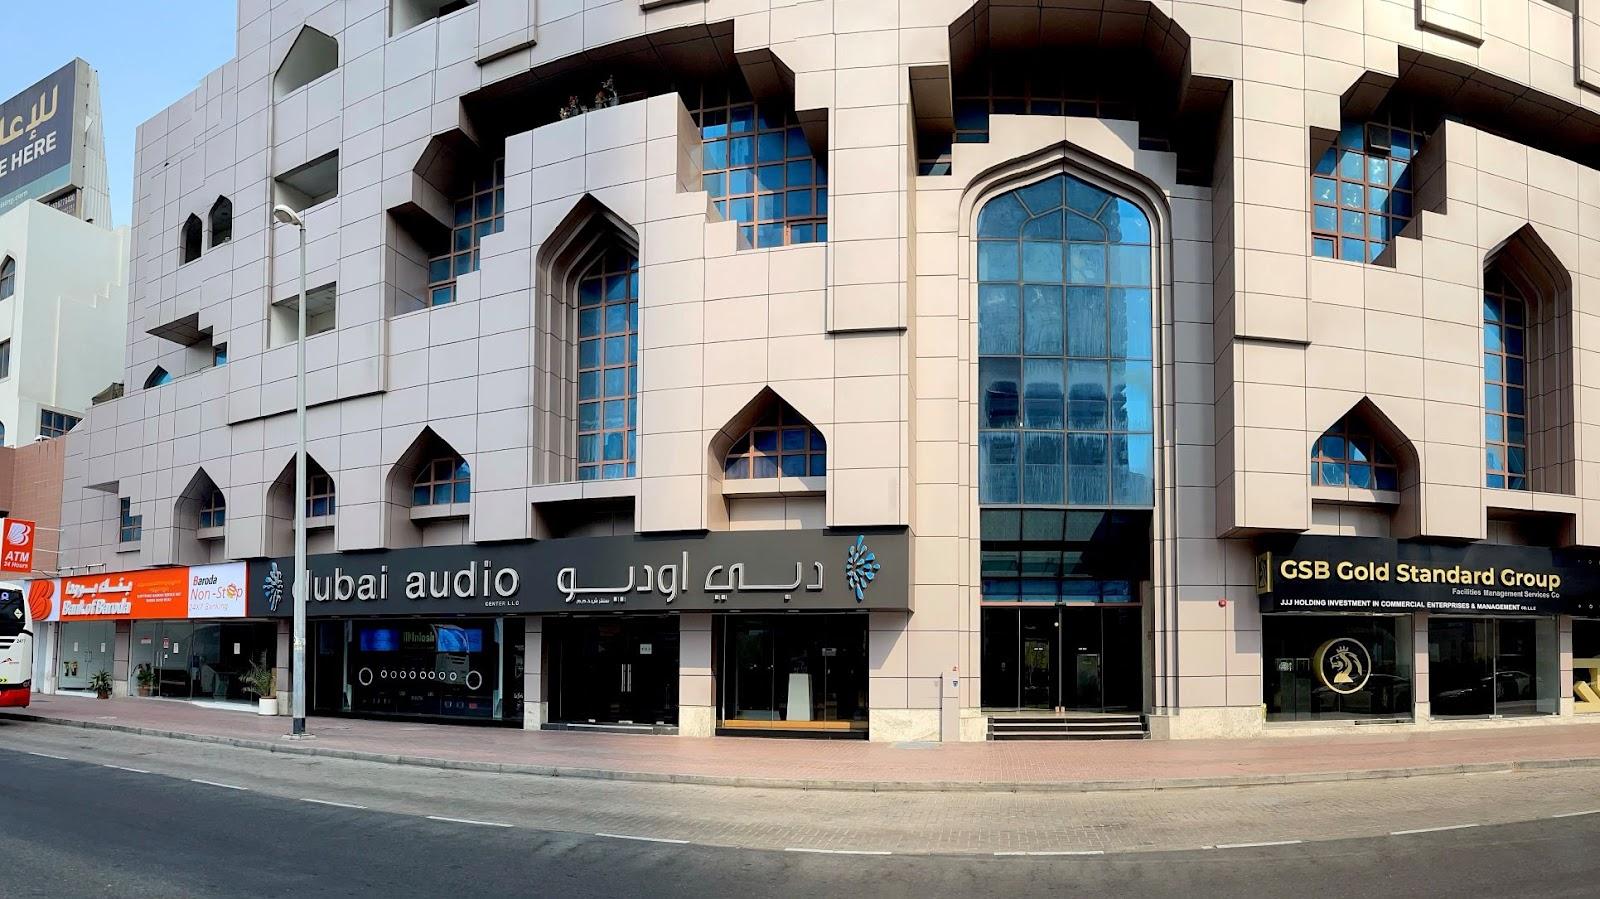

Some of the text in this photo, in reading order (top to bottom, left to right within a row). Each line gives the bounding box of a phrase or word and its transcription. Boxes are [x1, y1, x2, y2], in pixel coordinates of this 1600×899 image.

[11, 130, 57, 171] HERE
[5, 551, 30, 562] ATM
[193, 574, 218, 586] Baroda
[405, 560, 520, 601] audio
[704, 560, 824, 603] دبي
[1280, 560, 1561, 592] GSB Gold Standard Group
[1452, 588, 1481, 596] Facilities
[1483, 590, 1523, 599] Management
[1524, 591, 1550, 599] Services
[1477, 603, 1521, 611] MANAGEMENT
